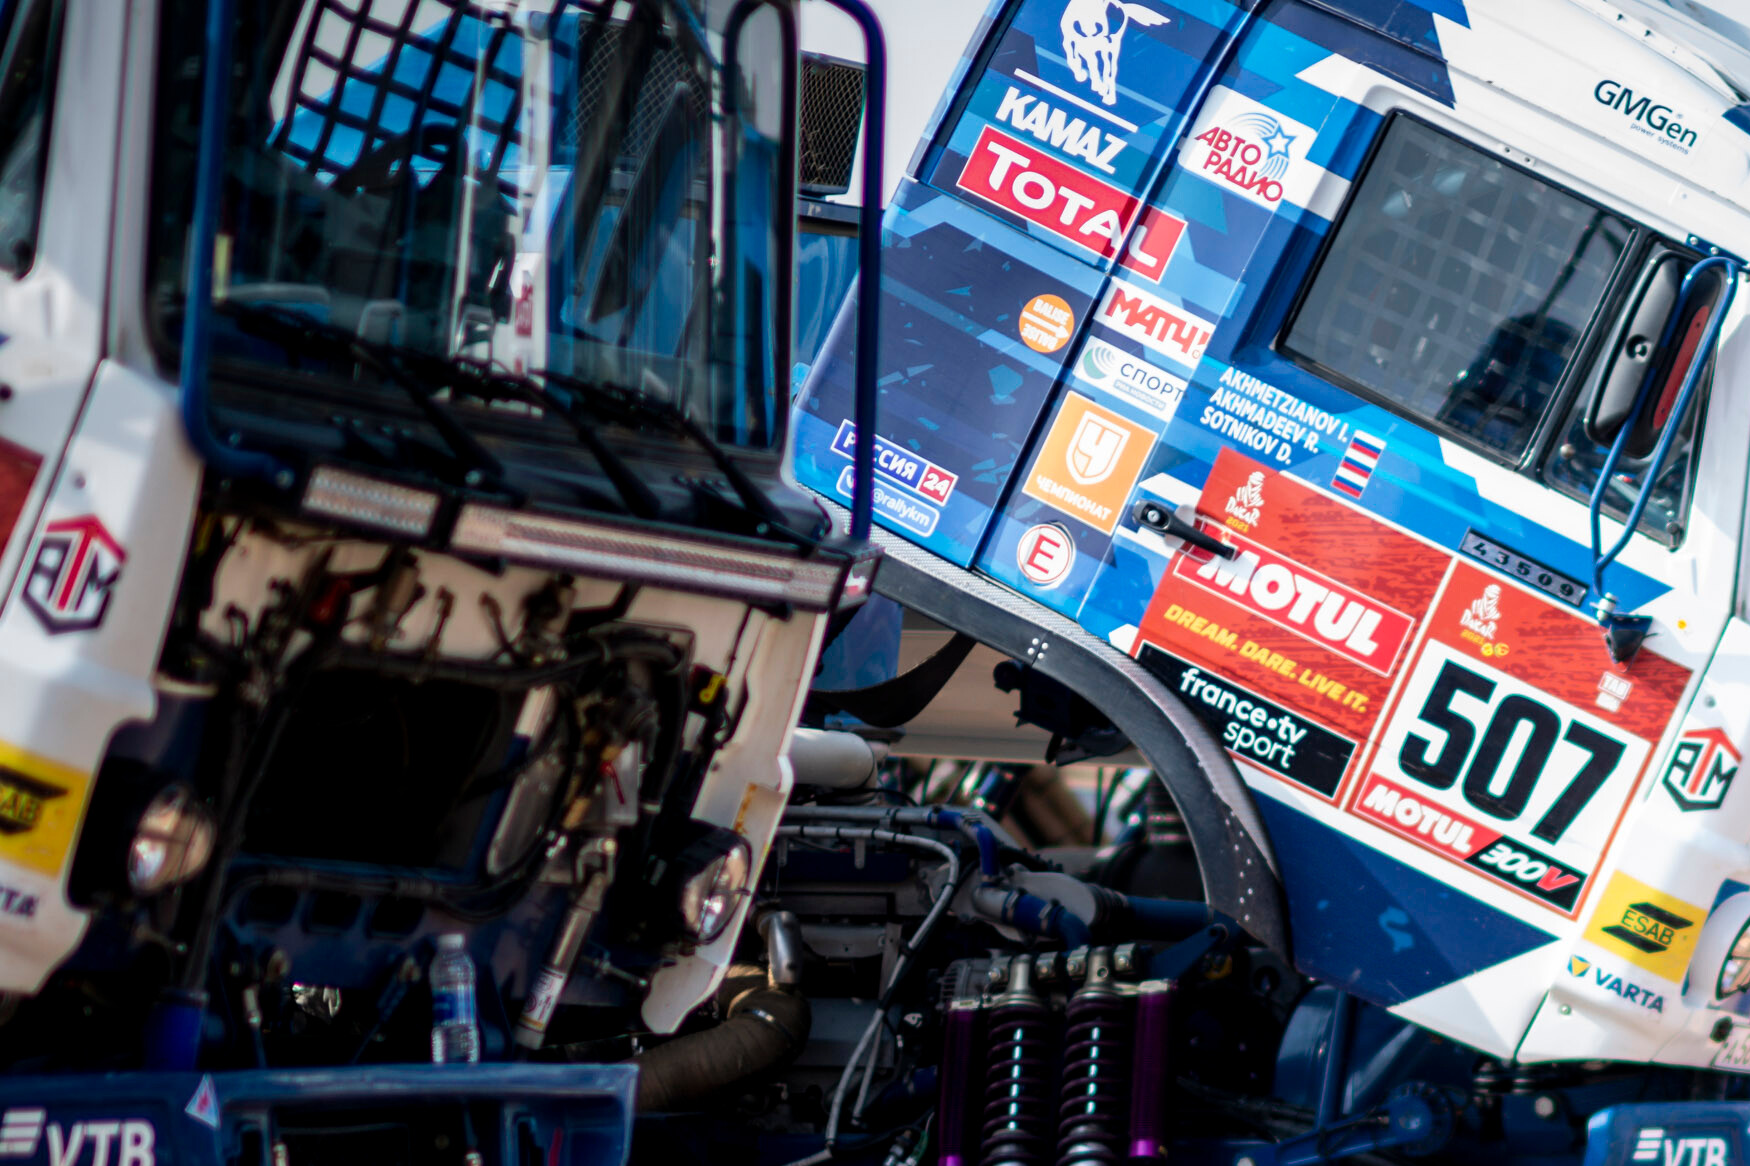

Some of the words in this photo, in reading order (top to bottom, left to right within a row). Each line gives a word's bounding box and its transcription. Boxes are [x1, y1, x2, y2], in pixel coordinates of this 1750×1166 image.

[995, 86, 1128, 174] KAMAZ
[1594, 79, 1698, 147] GMGen
[1194, 126, 1262, 166] АВТО
[986, 140, 1158, 268] TOTAL
[1203, 150, 1283, 202] РАДИО
[1120, 362, 1186, 403] СПОРТ
[1219, 366, 1341, 436] AKHMETZIANOV
[1200, 405, 1279, 456] SOTNIKOV
[1275, 442, 1293, 466] D.
[1209, 387, 1304, 445] AKHMADEEV
[1303, 431, 1320, 455] R.
[842, 430, 919, 482] РСИЯ
[923, 473, 951, 497] 24
[1036, 474, 1113, 522] ЧЕМПИОНАТ
[1225, 496, 1262, 528] DAKAR
[1225, 516, 1250, 534] 2021
[1025, 534, 1062, 576] E
[1198, 549, 1381, 659] MOTUL
[1163, 602, 1240, 652] DREAM.
[1239, 639, 1299, 682] DARE.
[1299, 666, 1342, 703] LIVE
[1337, 684, 1369, 715] IT.
[1223, 719, 1297, 771] sport
[1399, 657, 1629, 847] 507
[1363, 783, 1478, 855] MOTUL
[1477, 841, 1580, 893] 300V
[1619, 908, 1677, 949] ESAB
[1594, 966, 1666, 1015] VARTA
